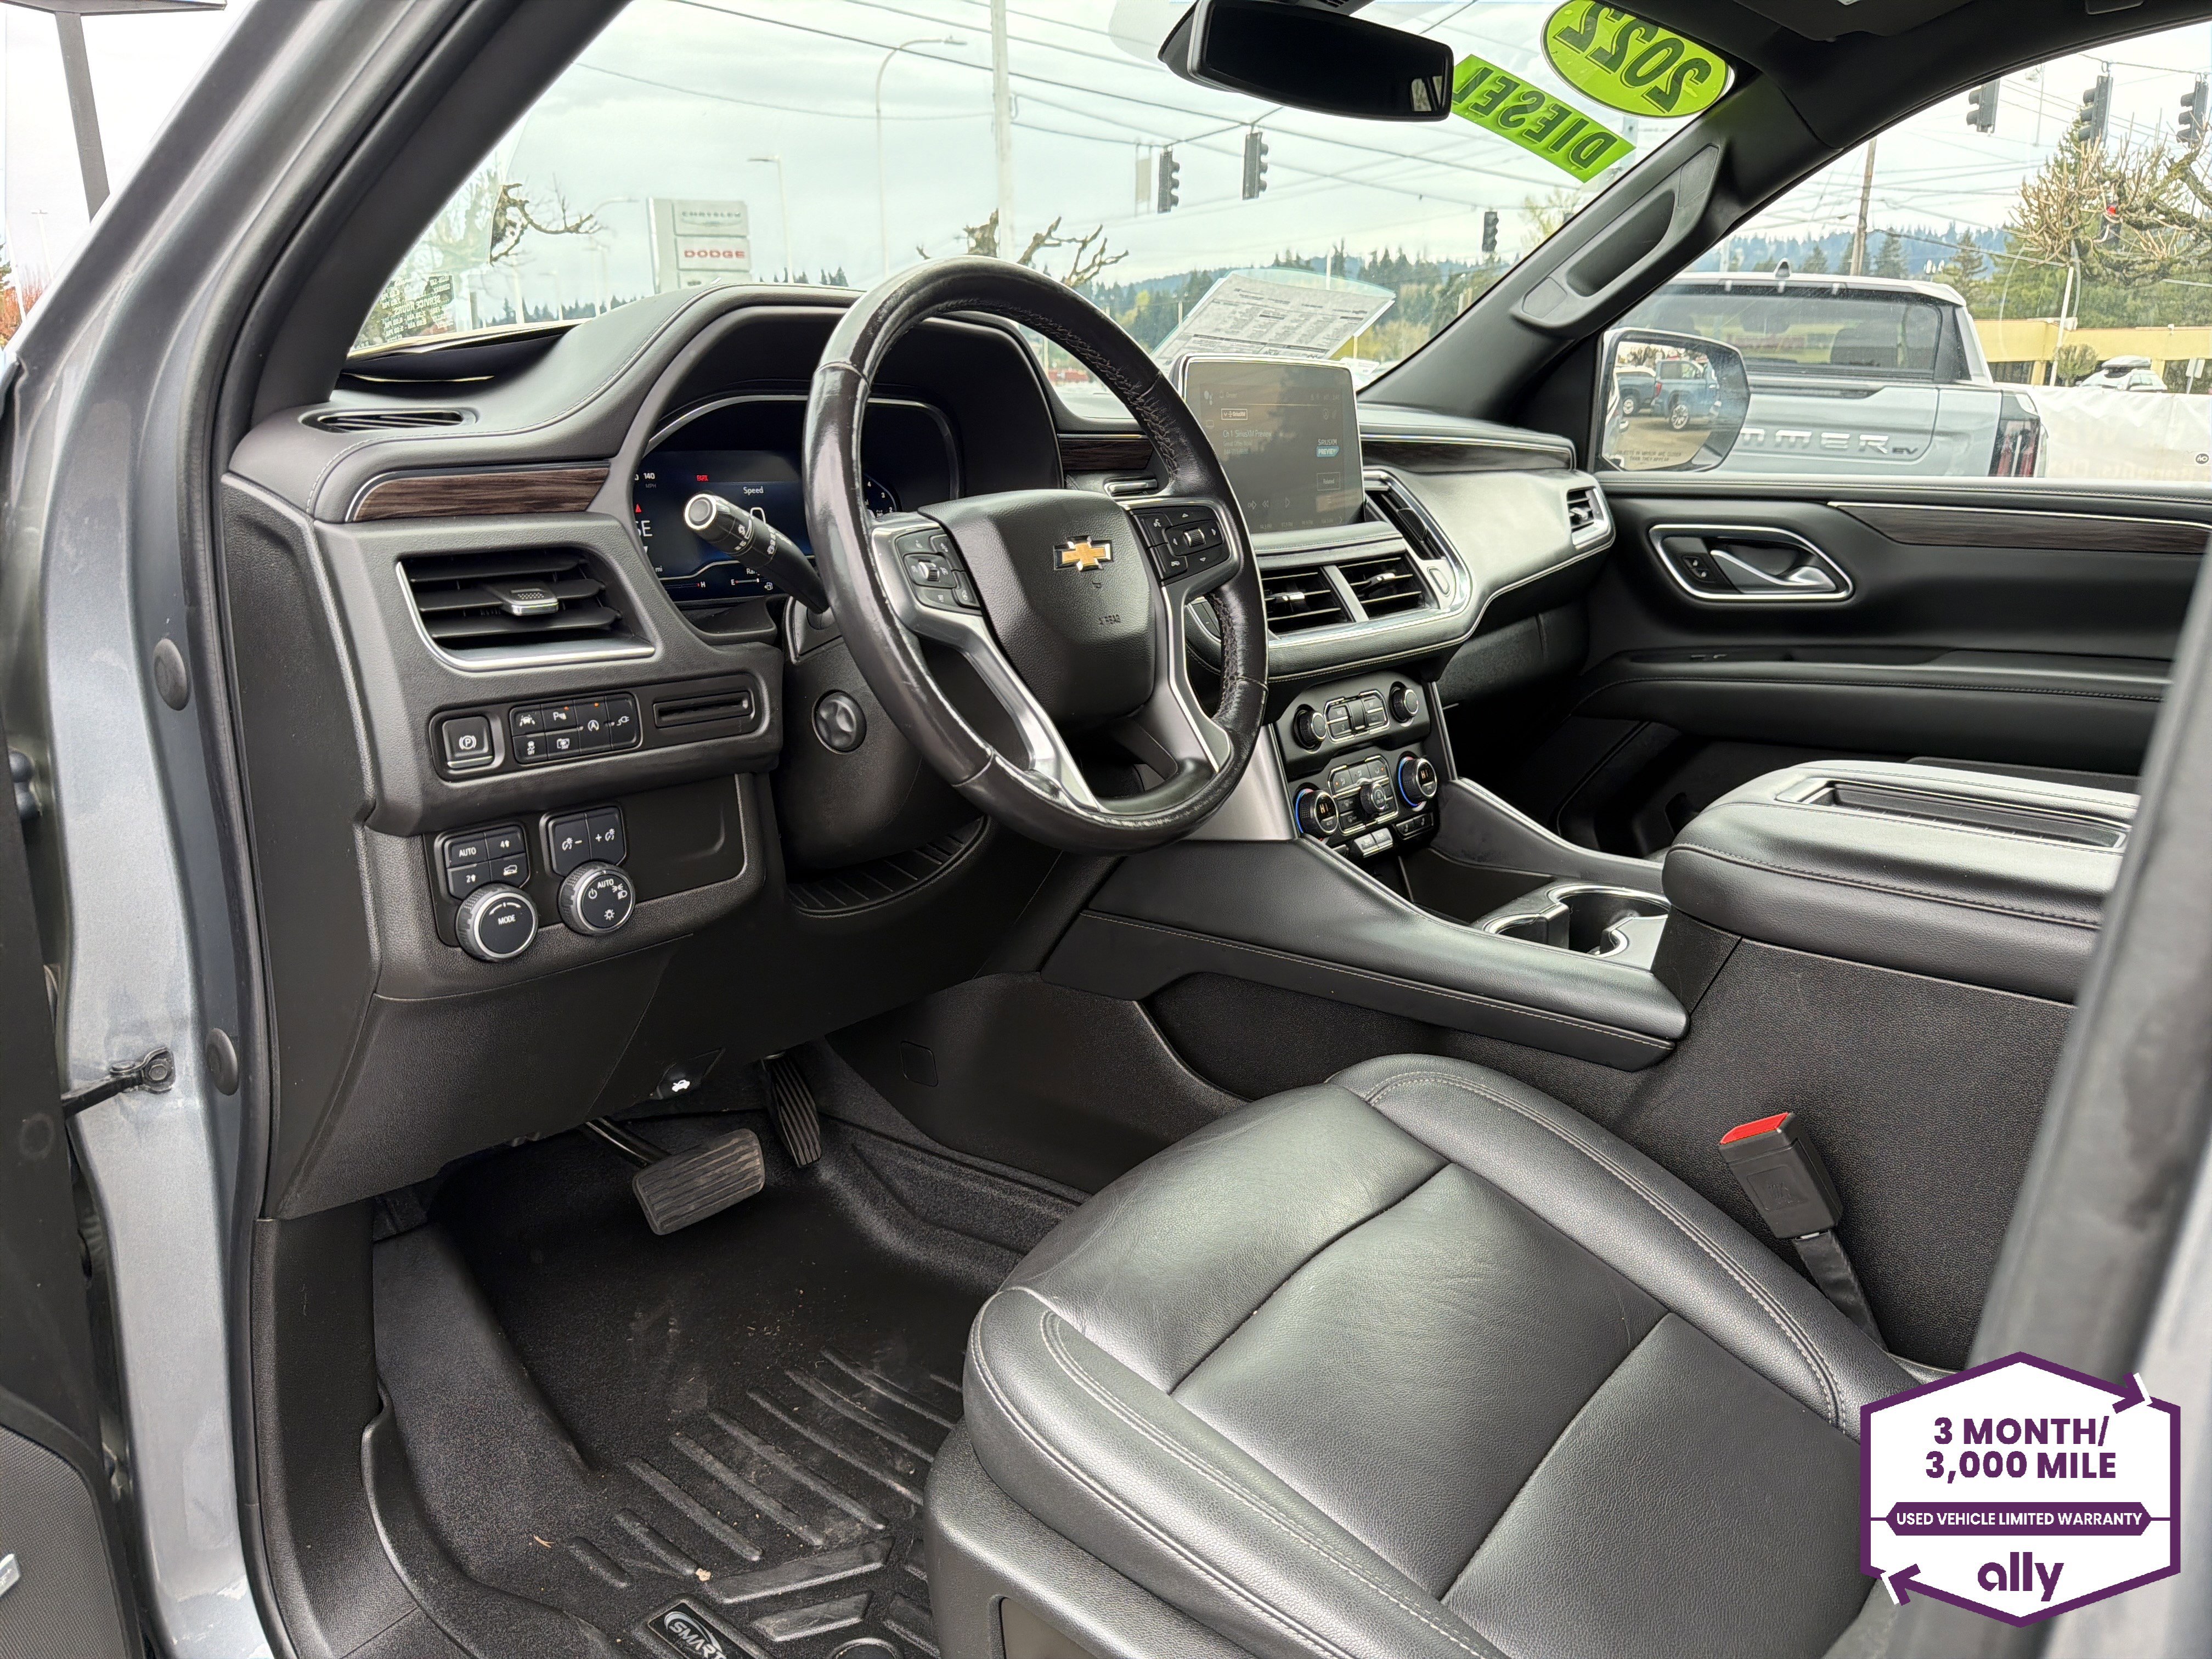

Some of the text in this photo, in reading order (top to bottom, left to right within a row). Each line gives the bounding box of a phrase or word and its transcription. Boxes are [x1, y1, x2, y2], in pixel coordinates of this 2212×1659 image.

[684, 250, 745, 259] DODGE
[1740, 428, 1889, 454] MMER
[743, 486, 764, 496] Speed
[459, 847, 477, 857] AUTO
[597, 878, 614, 889] AUTO
[498, 914, 516, 926] MODE
